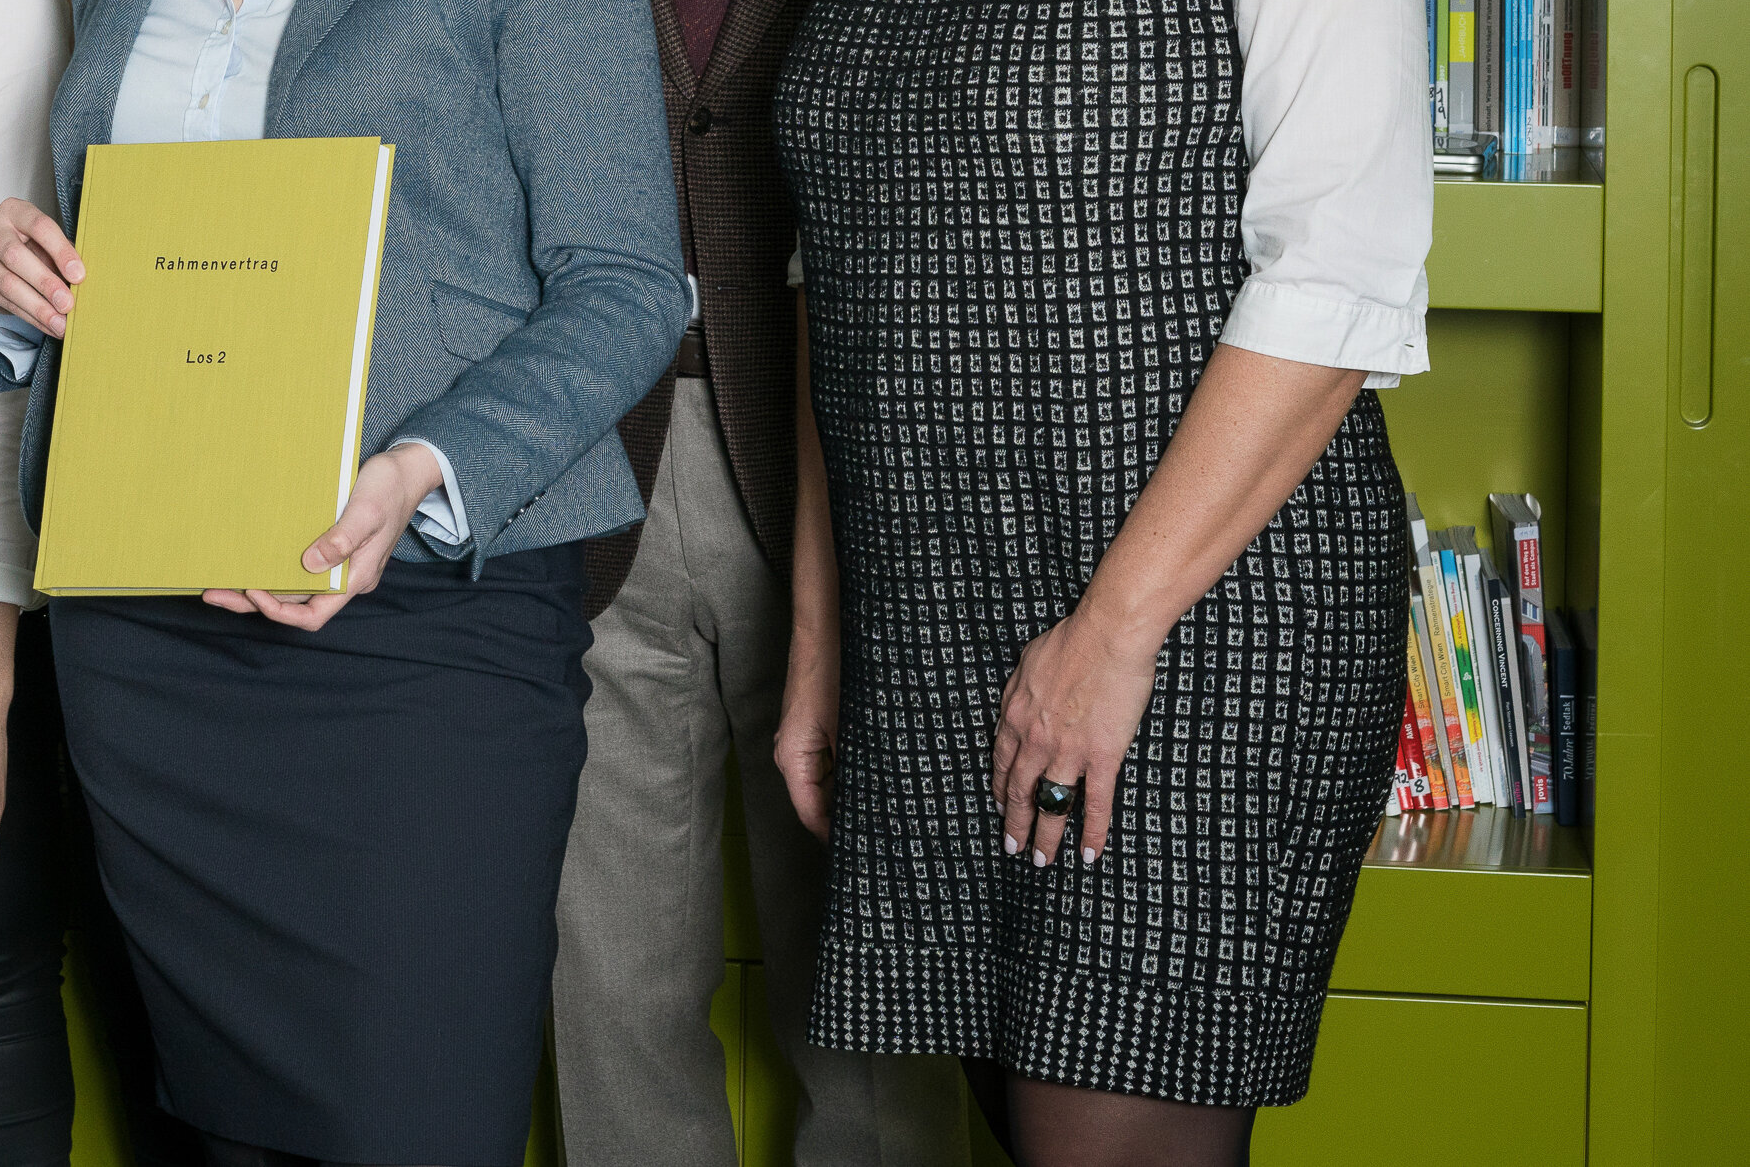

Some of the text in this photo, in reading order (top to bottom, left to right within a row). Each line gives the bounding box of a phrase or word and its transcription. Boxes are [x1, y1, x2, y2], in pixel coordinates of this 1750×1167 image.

[1458, 14, 1467, 58] JAHRBUCH
[154, 256, 280, 273] Rahmenvertrag
[186, 349, 227, 365] Los 2
[1523, 550, 1531, 562] Weg
[1530, 539, 1538, 560] Campus
[1523, 563, 1531, 574] dem
[1523, 575, 1531, 586] Auf
[1530, 570, 1538, 585] Stadt
[1425, 579, 1452, 697] Smart City Wien Rahmenstrategie
[1491, 599, 1508, 688] CONCERNING VINCENT
[1562, 701, 1576, 781] 70 Jahre Sedlak
[1415, 779, 1425, 793] 8
